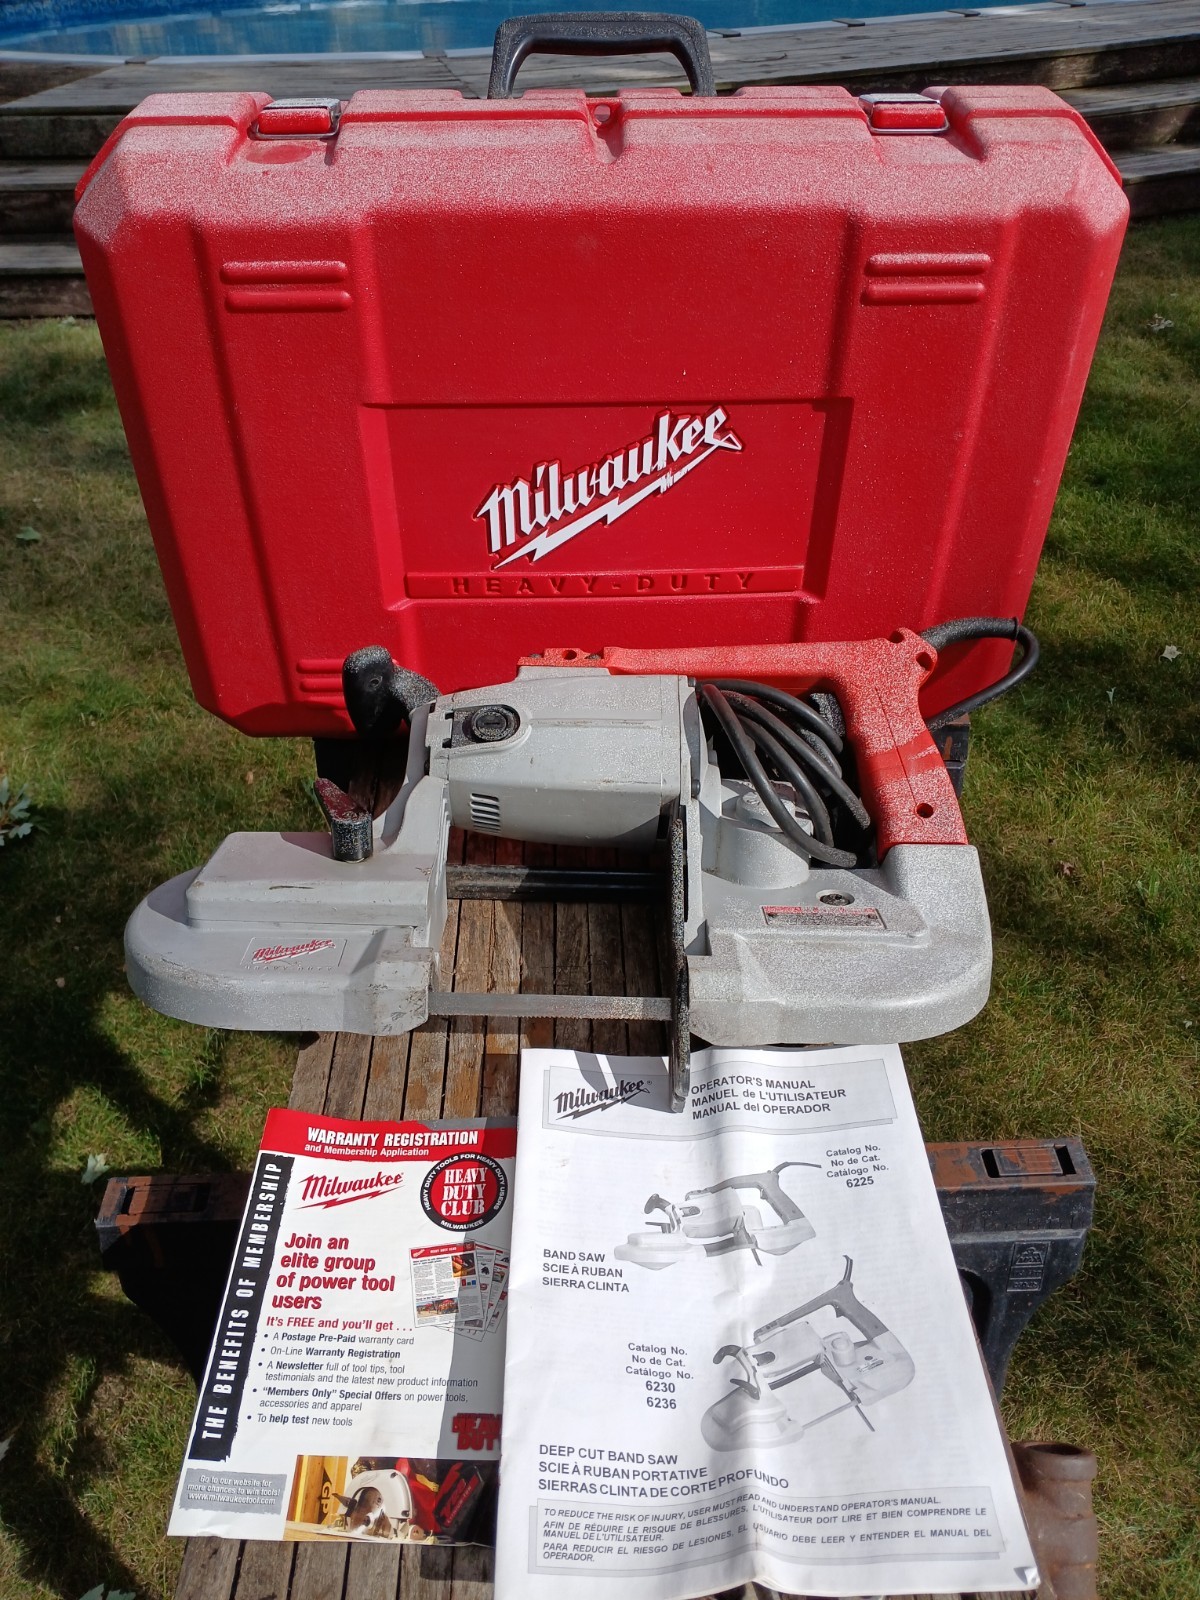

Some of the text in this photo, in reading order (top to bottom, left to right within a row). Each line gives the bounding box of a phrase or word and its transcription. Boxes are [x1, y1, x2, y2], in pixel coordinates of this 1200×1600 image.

[475, 404, 743, 555] Milwaukee
[452, 571, 754, 595] HEAVY-DUTY
[252, 939, 335, 961] Milwaukee
[691, 1075, 816, 1094] OPERATOR'S MANUAL
[553, 1079, 647, 1115] Milwaukee
[691, 1088, 846, 1107] MANUEL de L'UTILISATEUR
[692, 1102, 831, 1120] MANUAL del OPERADOR
[308, 1127, 478, 1147] WARRANTY REGISTRATION
[304, 1144, 429, 1157] and Membership Application
[826, 1148, 861, 1157] Catalog
[436, 1156, 459, 1170] TOOLS
[477, 1155, 497, 1168] HEAVY
[425, 1171, 436, 1187] DUTY
[444, 1167, 488, 1184] HEAVY
[495, 1168, 505, 1185] DUTY
[846, 1176, 874, 1188] 6225
[299, 1172, 404, 1201] Milwaukee
[442, 1184, 486, 1200] DUTY
[423, 1189, 431, 1210] HEAVY
[494, 1187, 505, 1210] USERS
[441, 1199, 484, 1216] CLUB
[440, 1219, 484, 1229] MILWAUKEE
[284, 1232, 349, 1250] Join an
[281, 1252, 376, 1272] elite group
[543, 1248, 605, 1263] BAND SAW
[542, 1261, 623, 1279] SCIE À RUBAN
[277, 1272, 396, 1292] of power tool
[542, 1276, 630, 1293] SIERRA CLINTA
[202, 1163, 282, 1440] THE BENEFITS OF MEMBERSHIP
[272, 1293, 322, 1309] users
[287, 1317, 315, 1327] FREE
[318, 1319, 339, 1328] and
[375, 1321, 393, 1332] get
[273, 1332, 414, 1345] A Postage Pre-Paid warranty card
[270, 1346, 400, 1359] On-Line Warranty Registration
[628, 1342, 687, 1355] Catalog No.
[267, 1361, 405, 1375] A Newsletter full of tool tips, tool
[632, 1354, 685, 1367] No de Cat.
[625, 1366, 694, 1379] Catálogo No.
[646, 1380, 675, 1393] 6230
[339, 1390, 371, 1400] Special
[375, 1391, 401, 1400] Offers
[417, 1394, 443, 1402] power
[445, 1394, 468, 1402] tools,
[646, 1397, 677, 1409] 6236
[257, 1413, 353, 1426] To help test new tools
[539, 1444, 678, 1465] DEEP CUT BAND SAW
[538, 1461, 708, 1481] SCIE À RUBAN PORTATIVE
[199, 1475, 209, 1483] Go
[220, 1477, 232, 1485] our
[233, 1478, 260, 1486] website
[261, 1479, 272, 1488] for
[538, 1468, 789, 1498] SIERRAS CLINTA DE CORTE PROFUNDO
[544, 1494, 941, 1522] TO REDUCE THE RISK OF INJURY, USER MUST READ AND UNDERSTAND OPERATOR'S MANUAL.
[544, 1521, 564, 1530] AFIN
[643, 1525, 676, 1534] RISQUE
[681, 1521, 692, 1530] DE
[696, 1505, 748, 1527] BLESSURES,
[753, 1504, 812, 1524] L'UTILISATEUR
[816, 1515, 837, 1524] DOIT
[842, 1514, 862, 1523] LIRE
[882, 1510, 903, 1518] BIEN
[907, 1508, 971, 1518] COMPRENDRE
[975, 1508, 986, 1516] LE
[544, 1530, 664, 1542] MANUEL DE L'UTILISATEUR.
